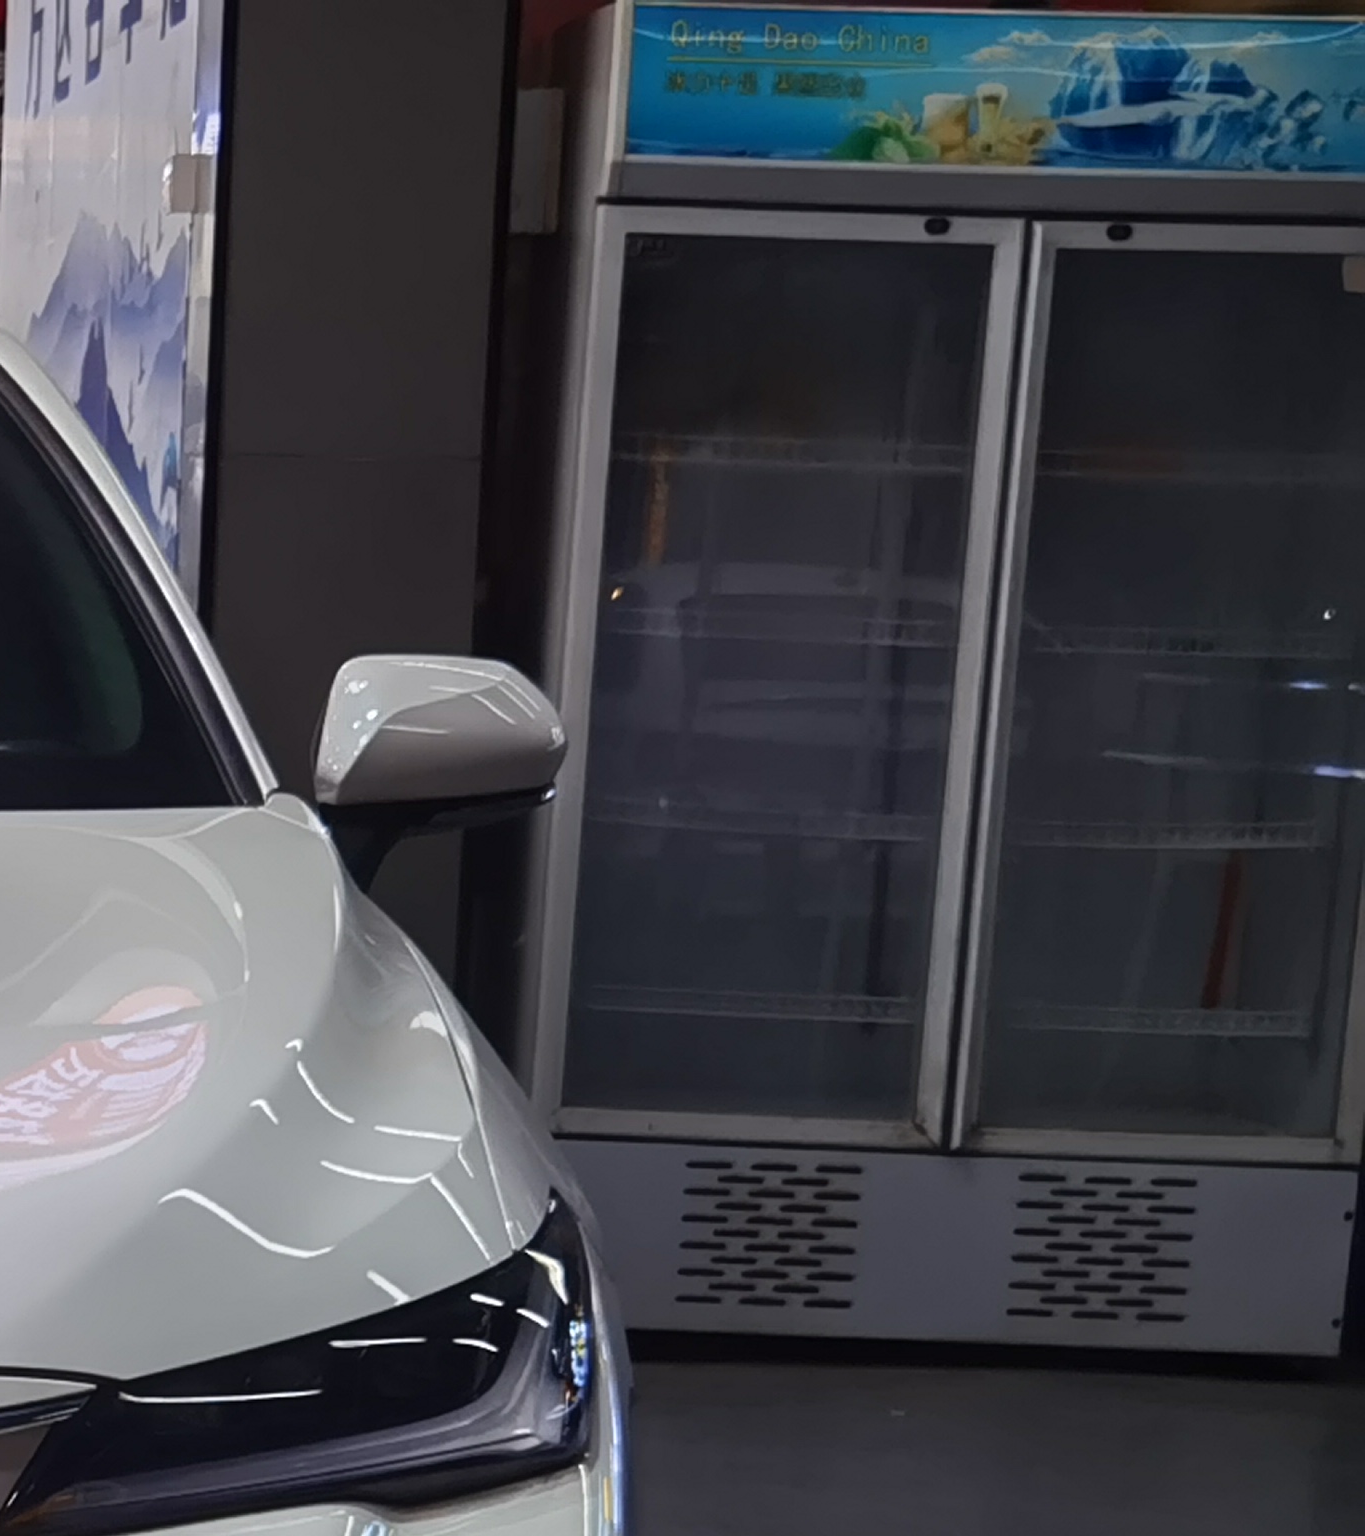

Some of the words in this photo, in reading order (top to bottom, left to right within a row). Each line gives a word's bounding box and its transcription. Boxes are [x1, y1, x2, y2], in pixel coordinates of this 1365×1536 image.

[670, 19, 746, 54] Qing
[764, 22, 819, 52] Dao
[837, 24, 931, 54] China
